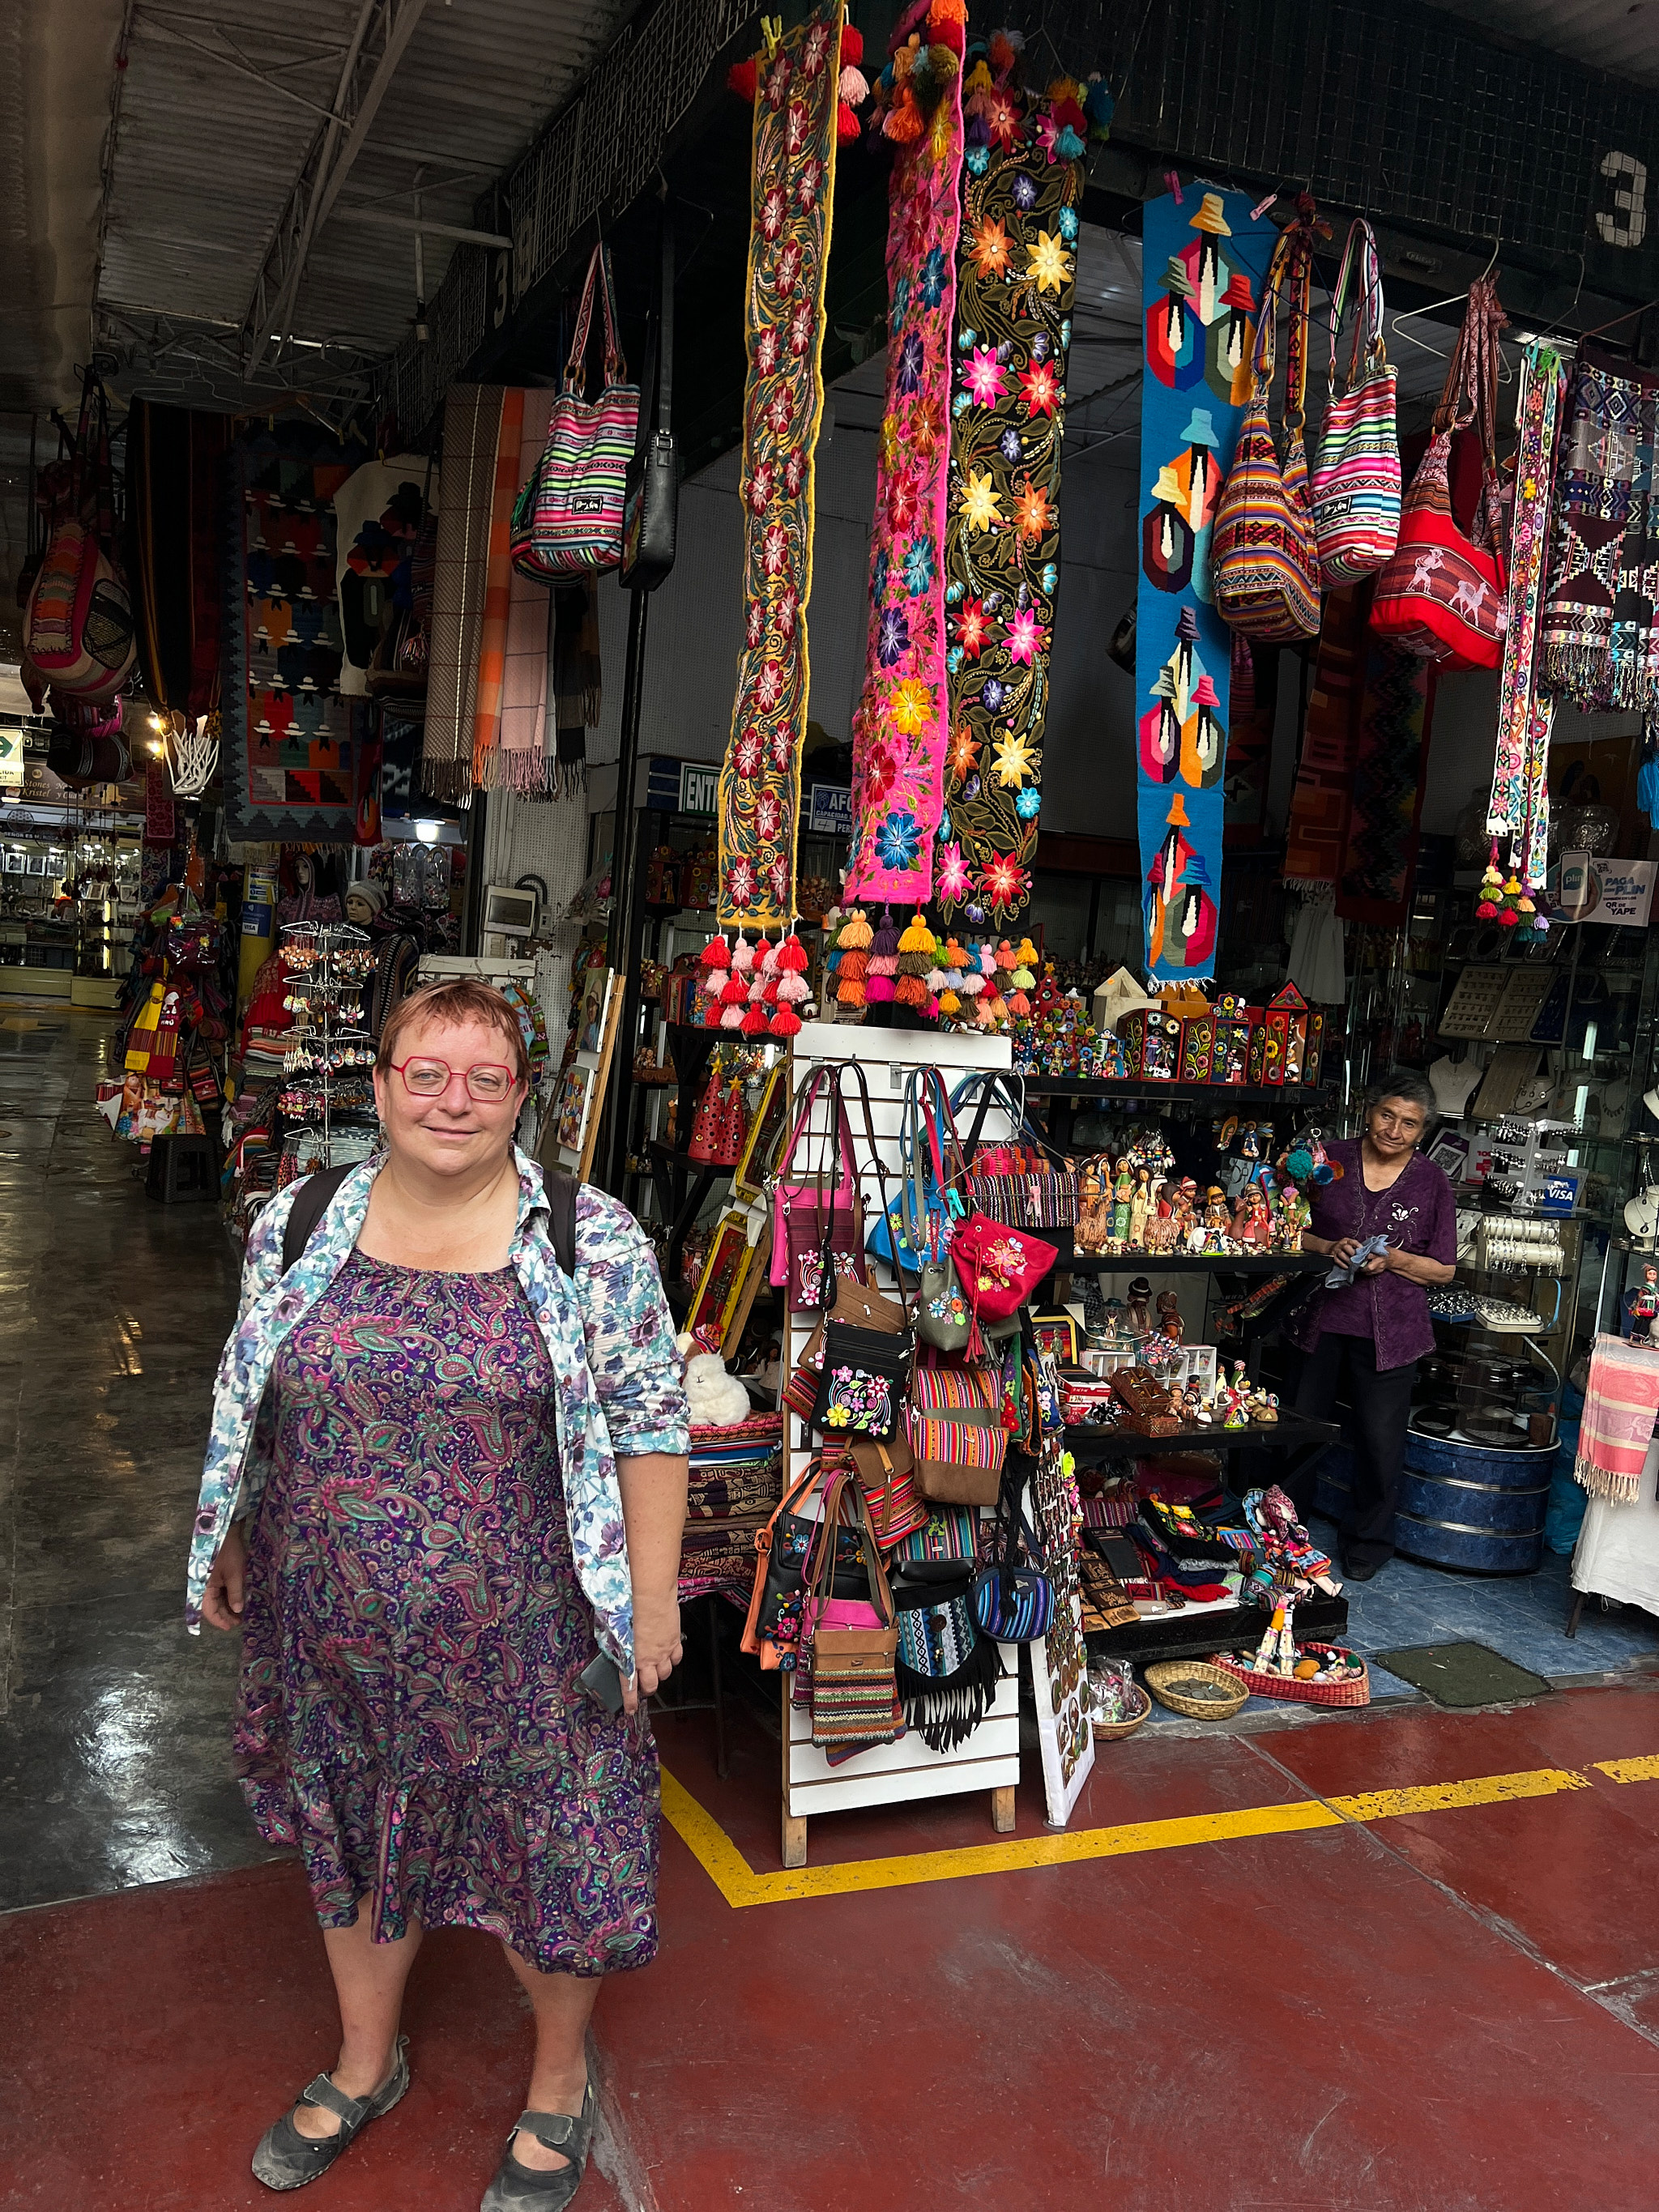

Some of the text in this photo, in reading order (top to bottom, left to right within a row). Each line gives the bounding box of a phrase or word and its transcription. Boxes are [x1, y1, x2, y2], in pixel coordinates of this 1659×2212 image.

[1596, 151, 1647, 247] 3
[24, 778, 49, 788] Stones
[23, 787, 50, 798] Kristel
[816, 810, 849, 820] CAPACIDAD
[1565, 874, 1583, 885] plin
[1605, 876, 1635, 886] PAGA
[1614, 884, 1646, 895] PLIN
[1611, 907, 1636, 915] YAPE
[1548, 1188, 1573, 1201] VISA
